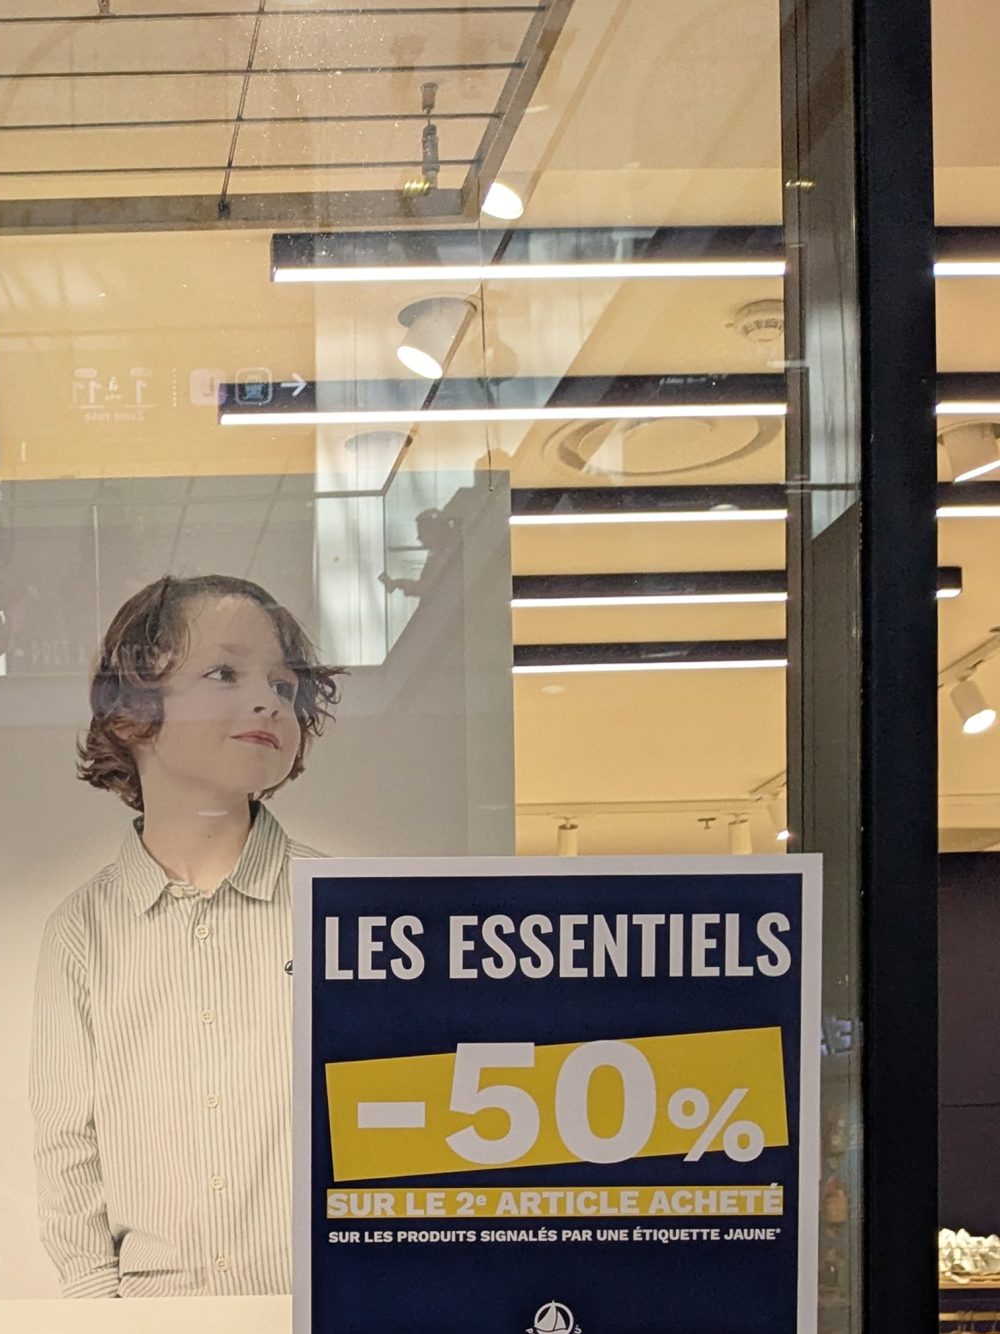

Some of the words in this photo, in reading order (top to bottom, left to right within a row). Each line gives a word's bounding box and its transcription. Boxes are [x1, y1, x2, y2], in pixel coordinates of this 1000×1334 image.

[325, 914, 425, 980] LES
[449, 911, 791, 979] ESSENTIELS
[357, 1040, 765, 1164] -50%
[327, 1192, 395, 1217] SUR
[406, 1192, 446, 1216] LE
[495, 1190, 640, 1216] ARTICLE
[650, 1182, 782, 1215] ACHETÉ
[328, 1230, 360, 1243] SUR
[364, 1231, 393, 1243] LES
[397, 1230, 477, 1243] PRODUITS
[480, 1227, 557, 1242] SIGNALÉS
[562, 1229, 592, 1242] PAR
[596, 1229, 629, 1242] UNE
[633, 1226, 720, 1243] ÉTIQUETTE
